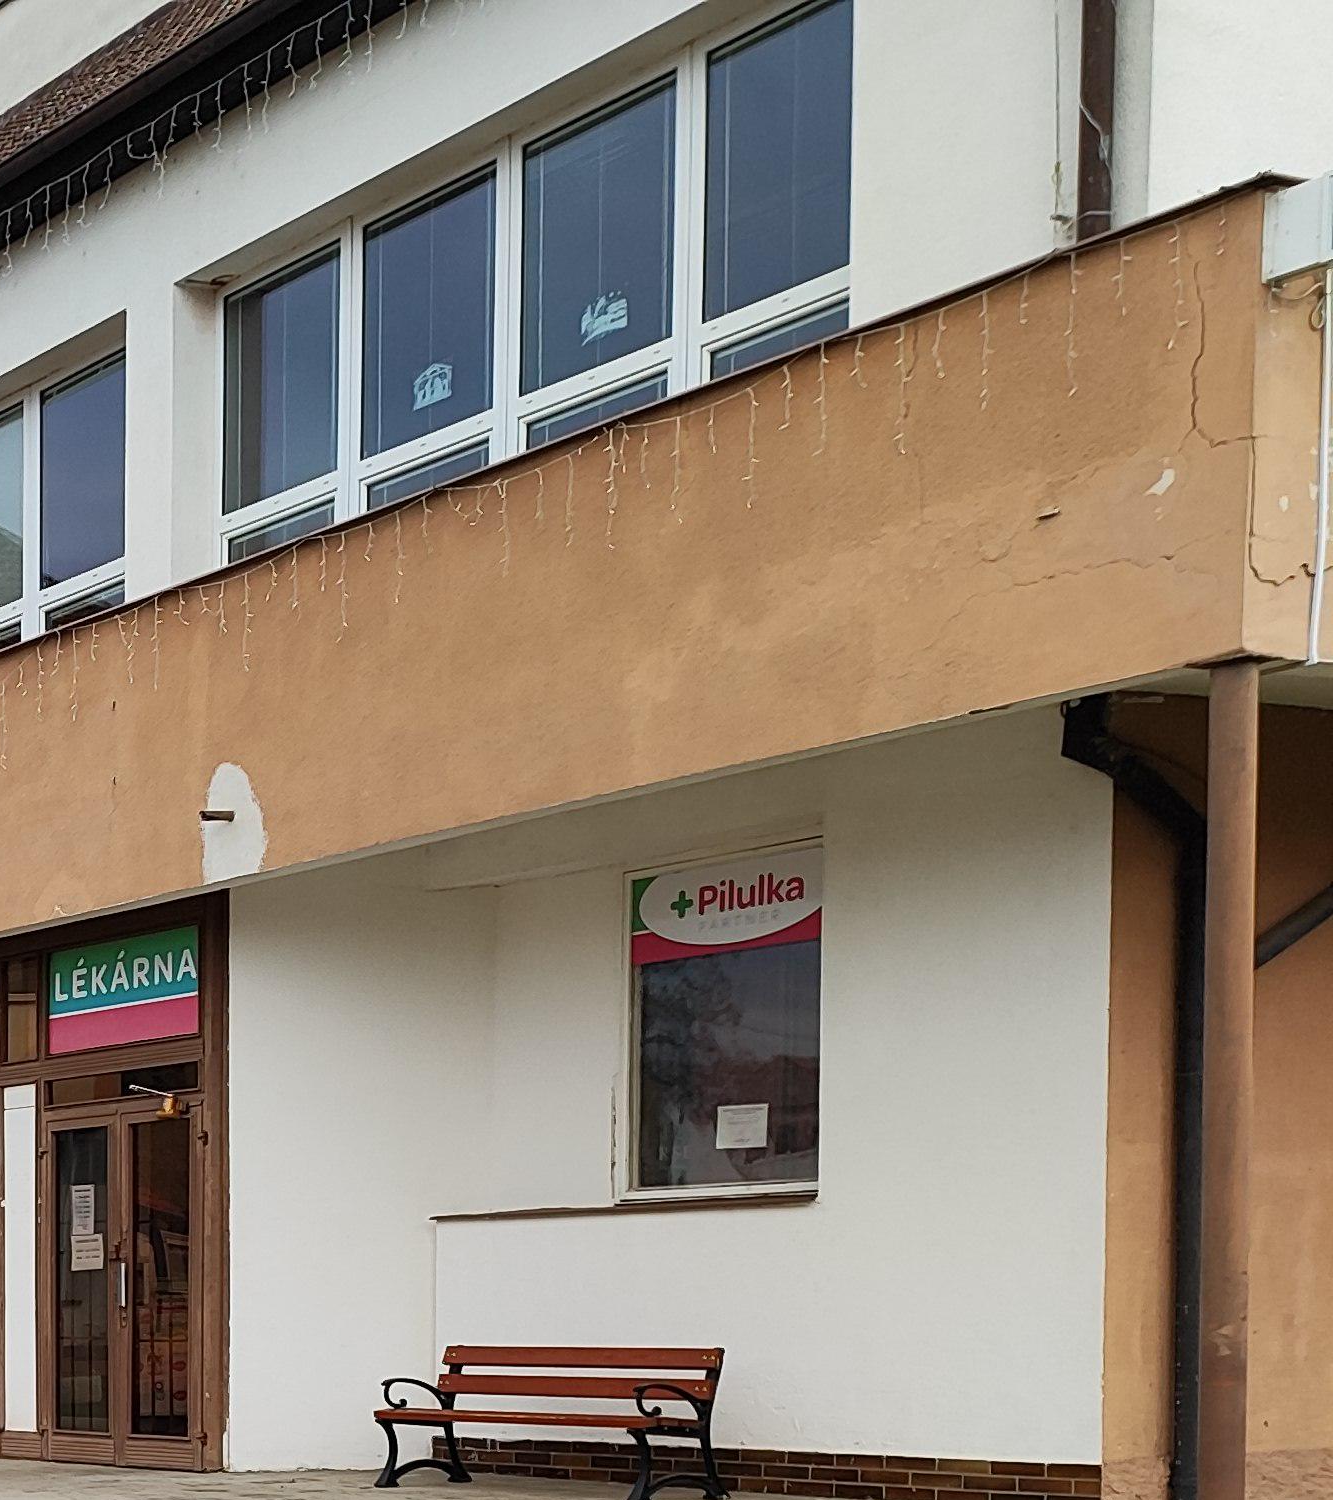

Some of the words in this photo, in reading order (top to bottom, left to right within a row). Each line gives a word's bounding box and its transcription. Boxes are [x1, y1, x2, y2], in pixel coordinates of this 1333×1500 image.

[698, 872, 805, 916] Pilulka
[698, 909, 780, 933] PARTNER
[54, 948, 197, 1002] LÉKÁRNA
